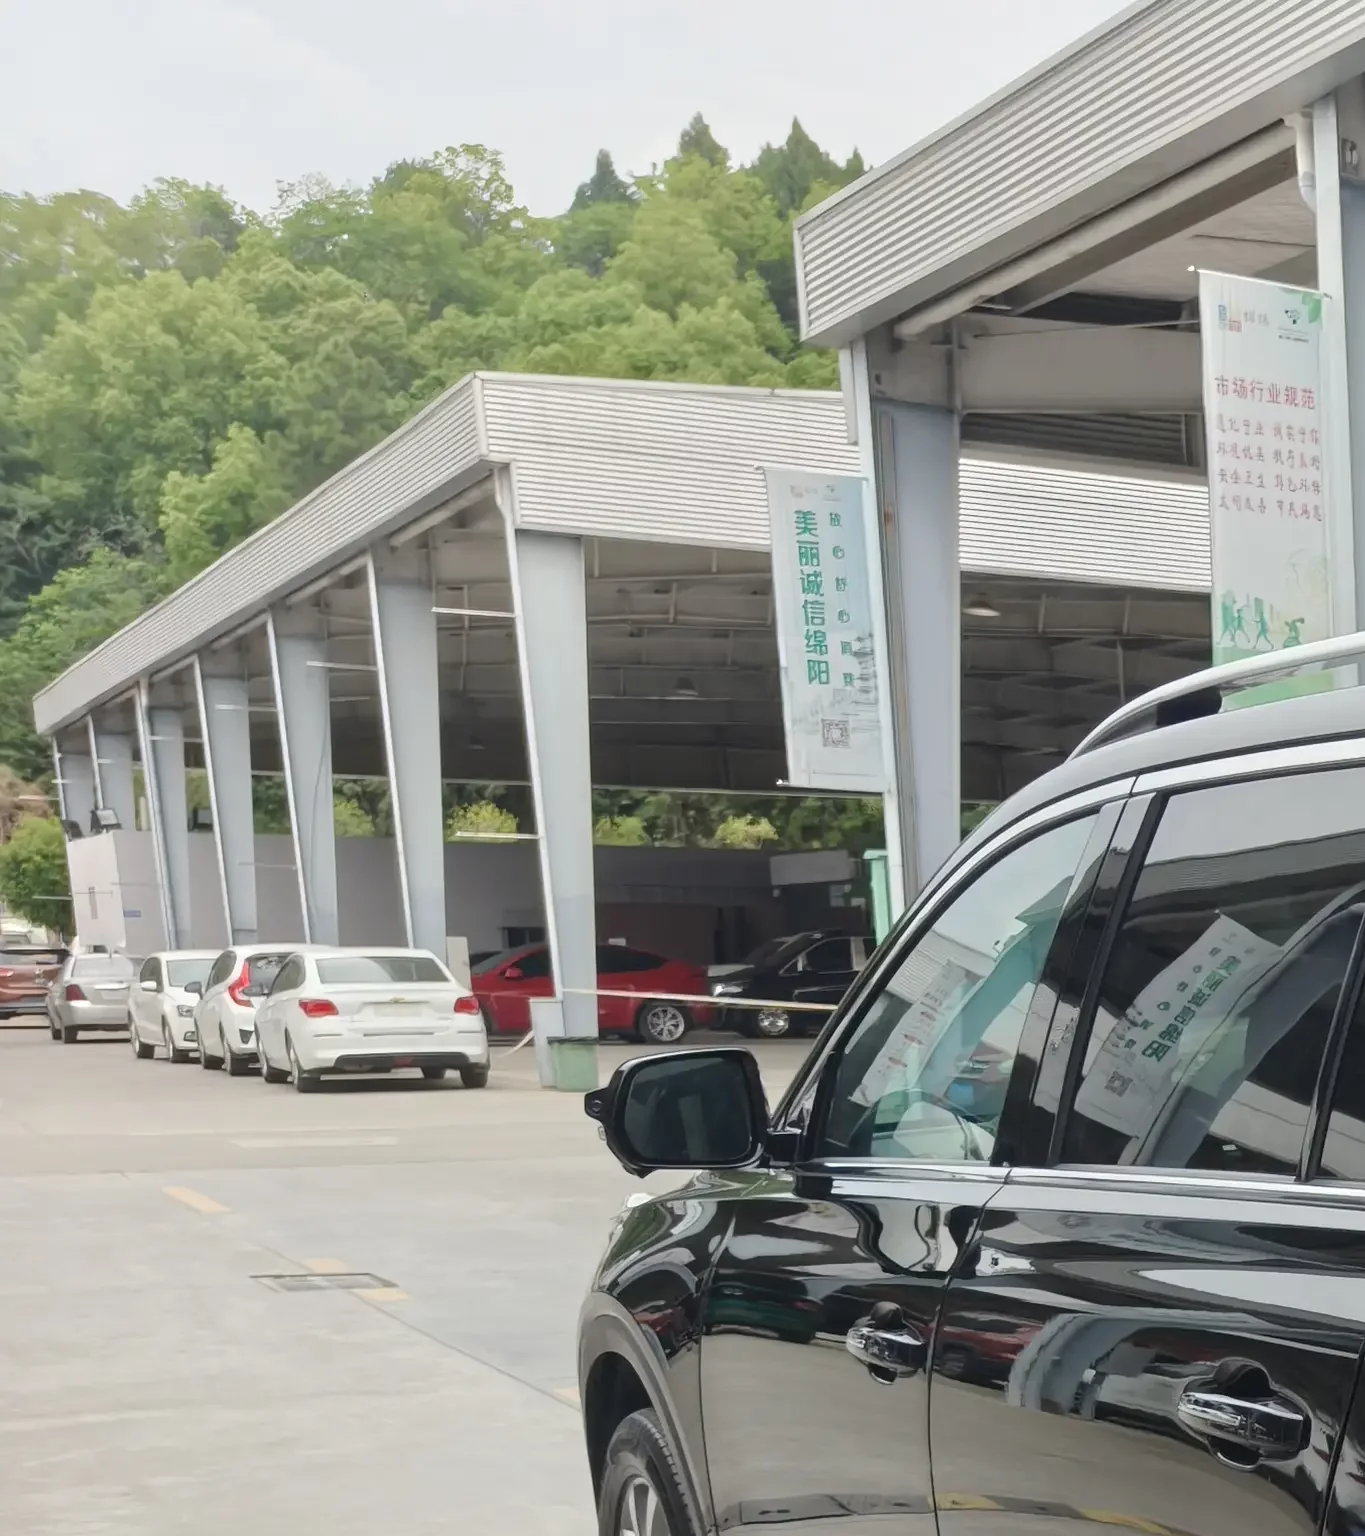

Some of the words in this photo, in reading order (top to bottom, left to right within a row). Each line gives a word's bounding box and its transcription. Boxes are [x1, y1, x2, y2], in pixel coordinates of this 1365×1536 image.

[1214, 374, 1317, 411] 市场行业规范
[794, 509, 831, 686] 美丽诚信绵阳
